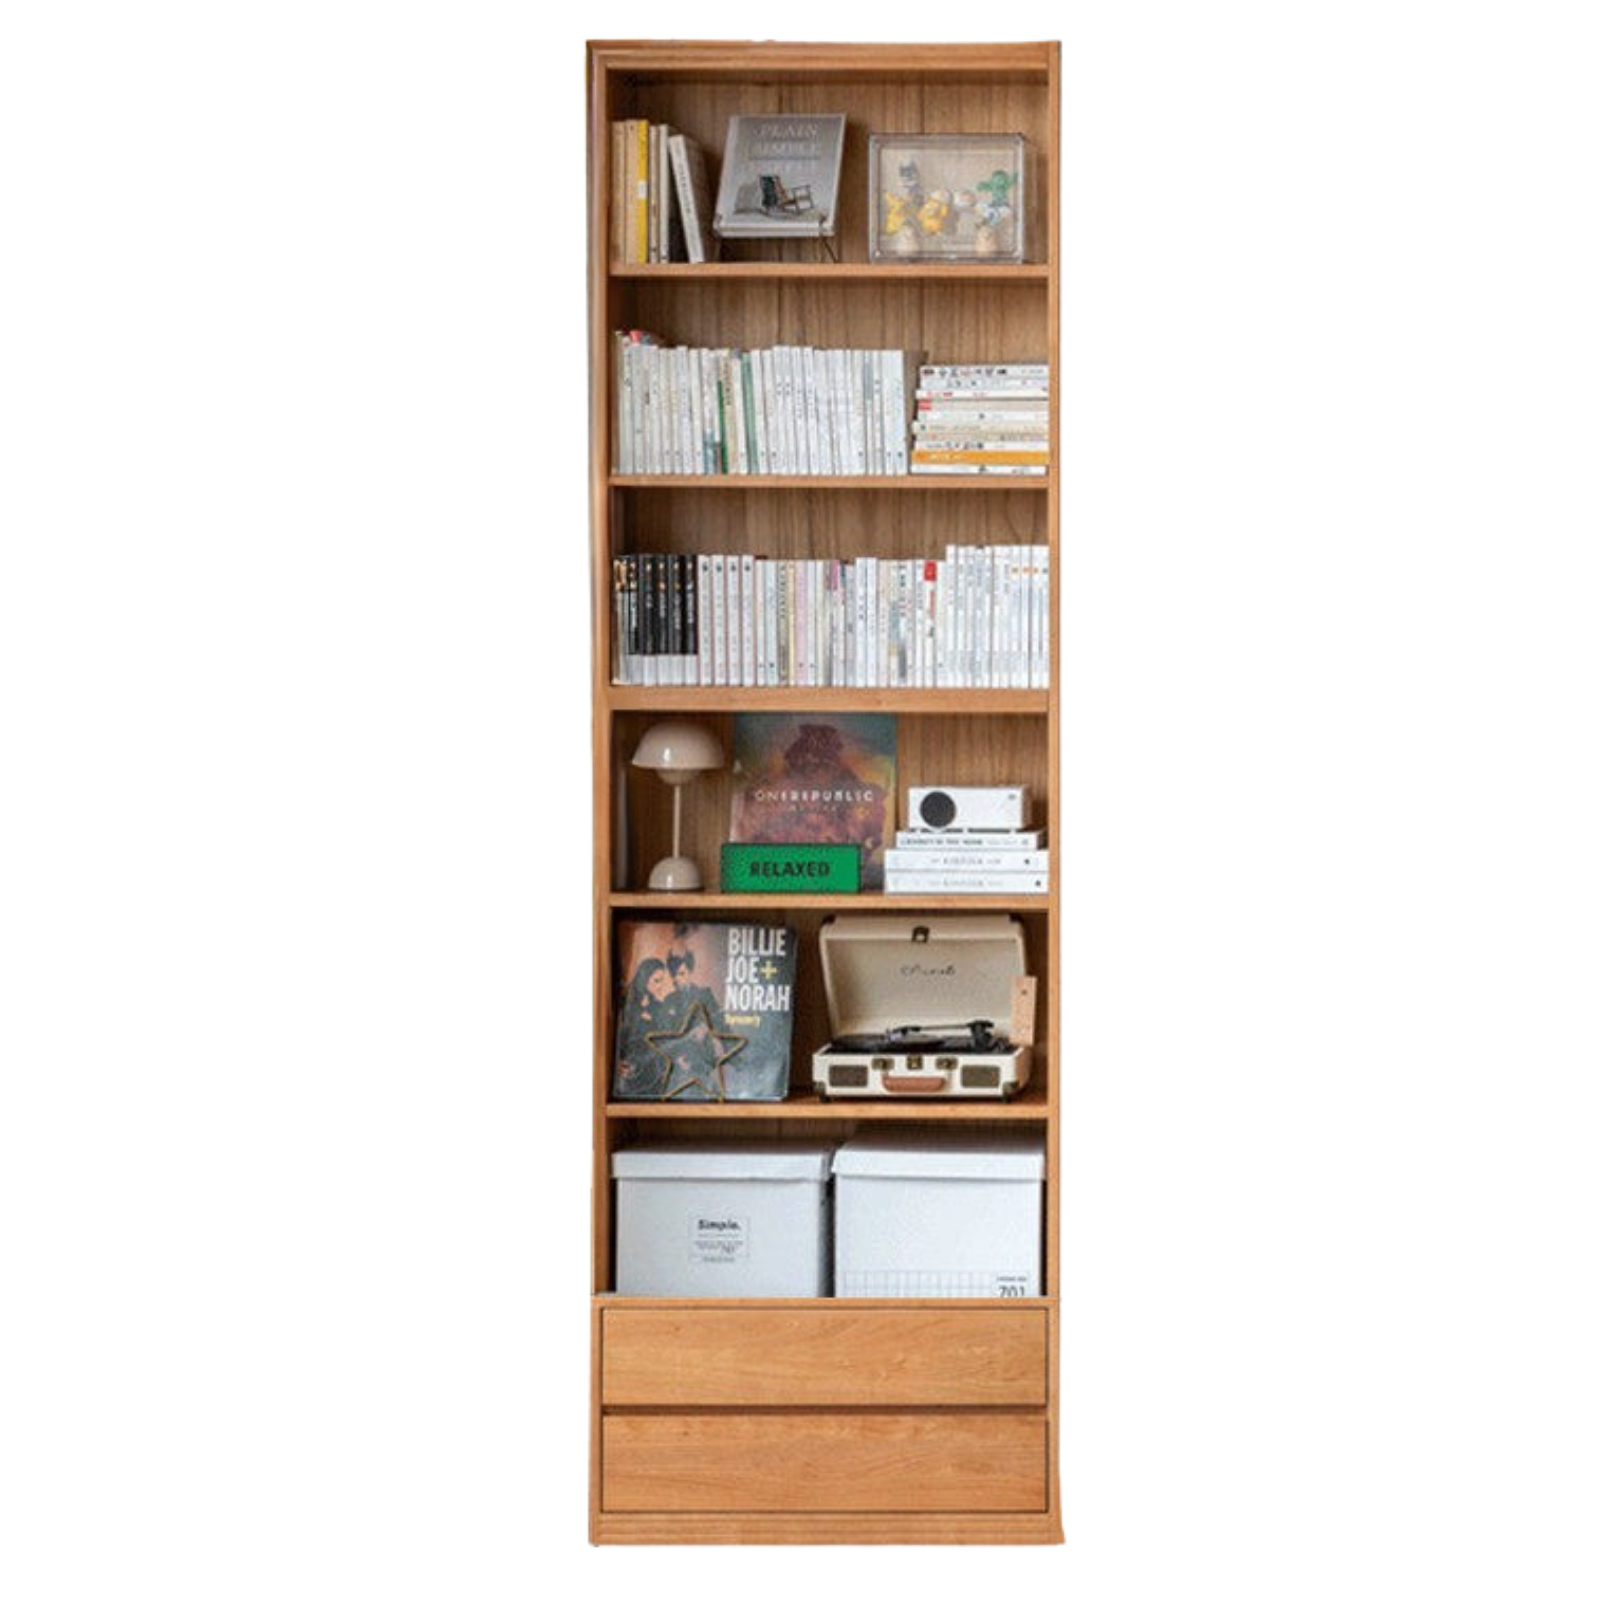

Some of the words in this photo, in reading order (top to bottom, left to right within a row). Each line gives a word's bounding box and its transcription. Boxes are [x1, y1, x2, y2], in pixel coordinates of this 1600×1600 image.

[749, 860, 831, 878] RELAXED
[728, 927, 786, 956] BILLIE
[725, 984, 790, 1012] NORAH
